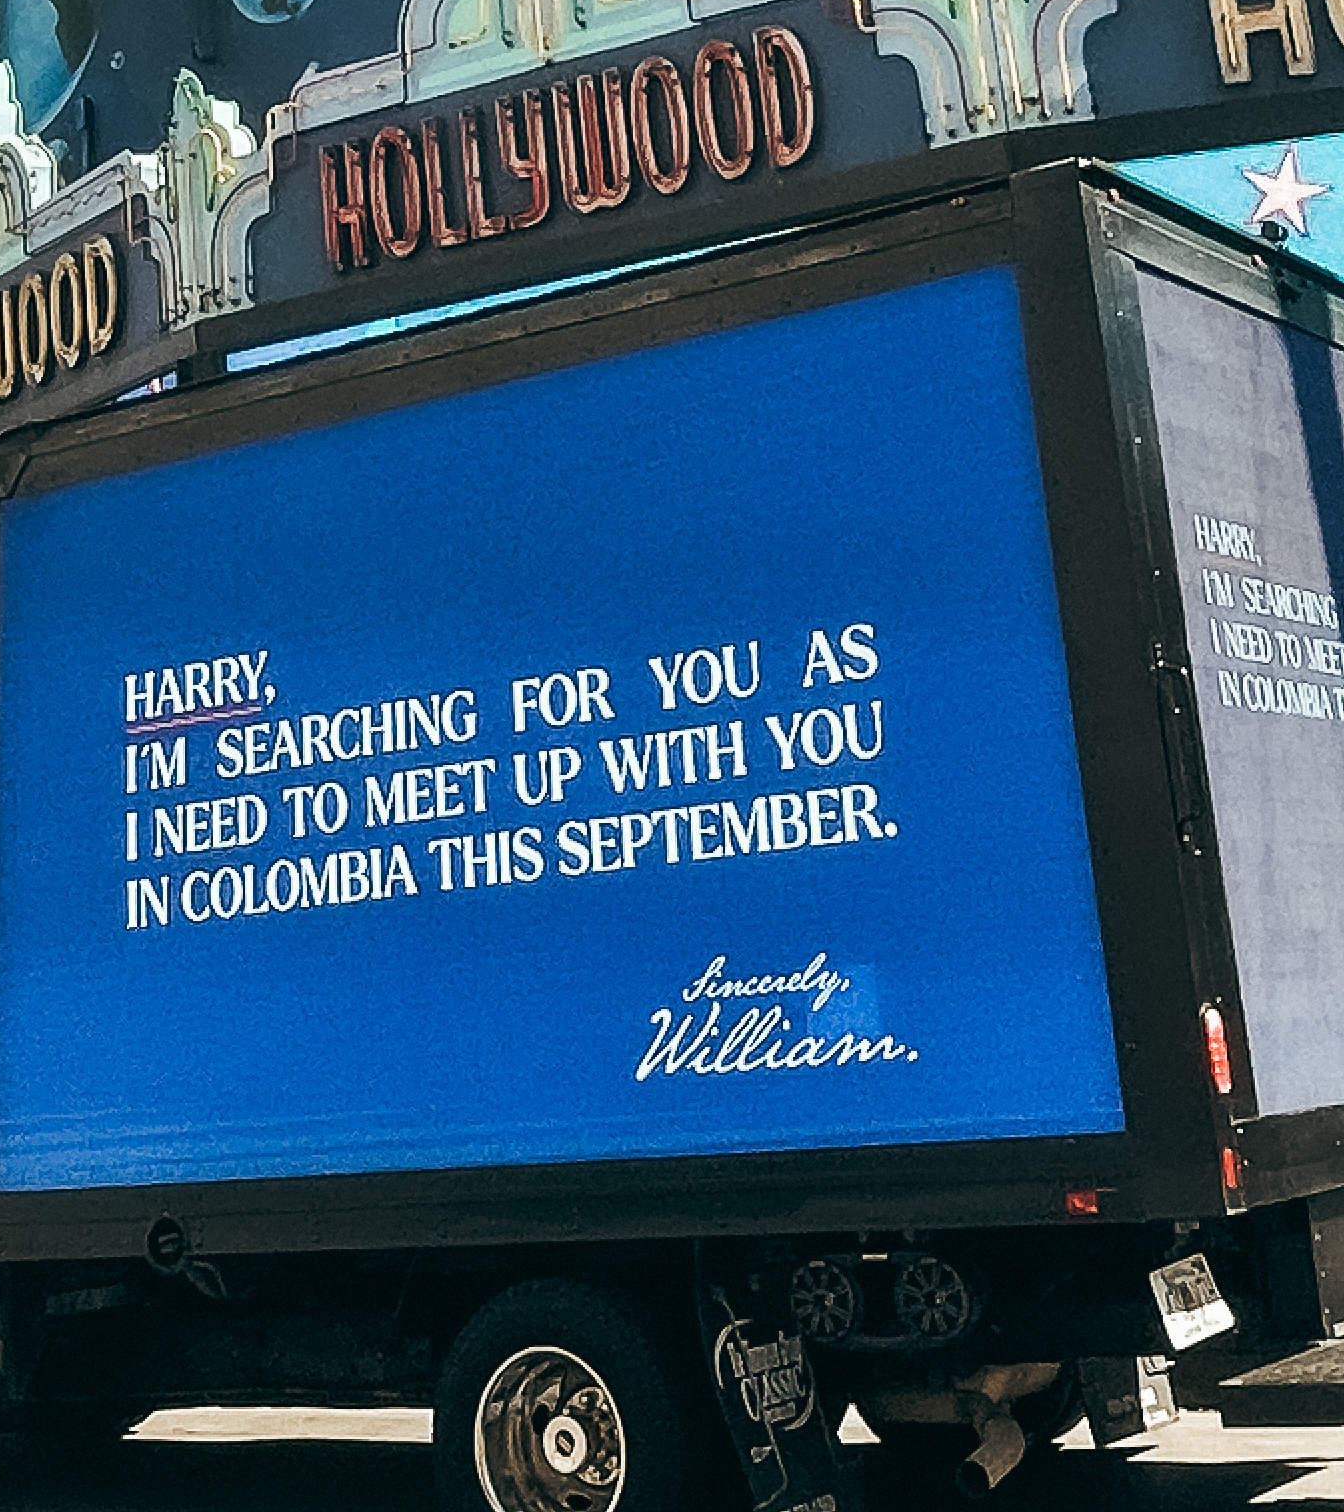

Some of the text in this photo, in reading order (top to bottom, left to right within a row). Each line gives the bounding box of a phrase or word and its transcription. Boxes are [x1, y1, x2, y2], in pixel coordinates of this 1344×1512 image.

[319, 25, 814, 272] HOLLYWOOD
[124, 650, 276, 722] HARRY,
[1223, 620, 1274, 665] NEED
[1275, 630, 1302, 670] TO
[126, 624, 878, 794] I'M SEARCHING FOR YOU AS
[126, 700, 882, 862] I NEED TO MEET UP WITH YOU
[126, 784, 898, 930] IN COLOMBIA THIS SEPTEMBER.
[682, 952, 851, 1012] Sincerely,
[635, 1000, 919, 1082] William.
